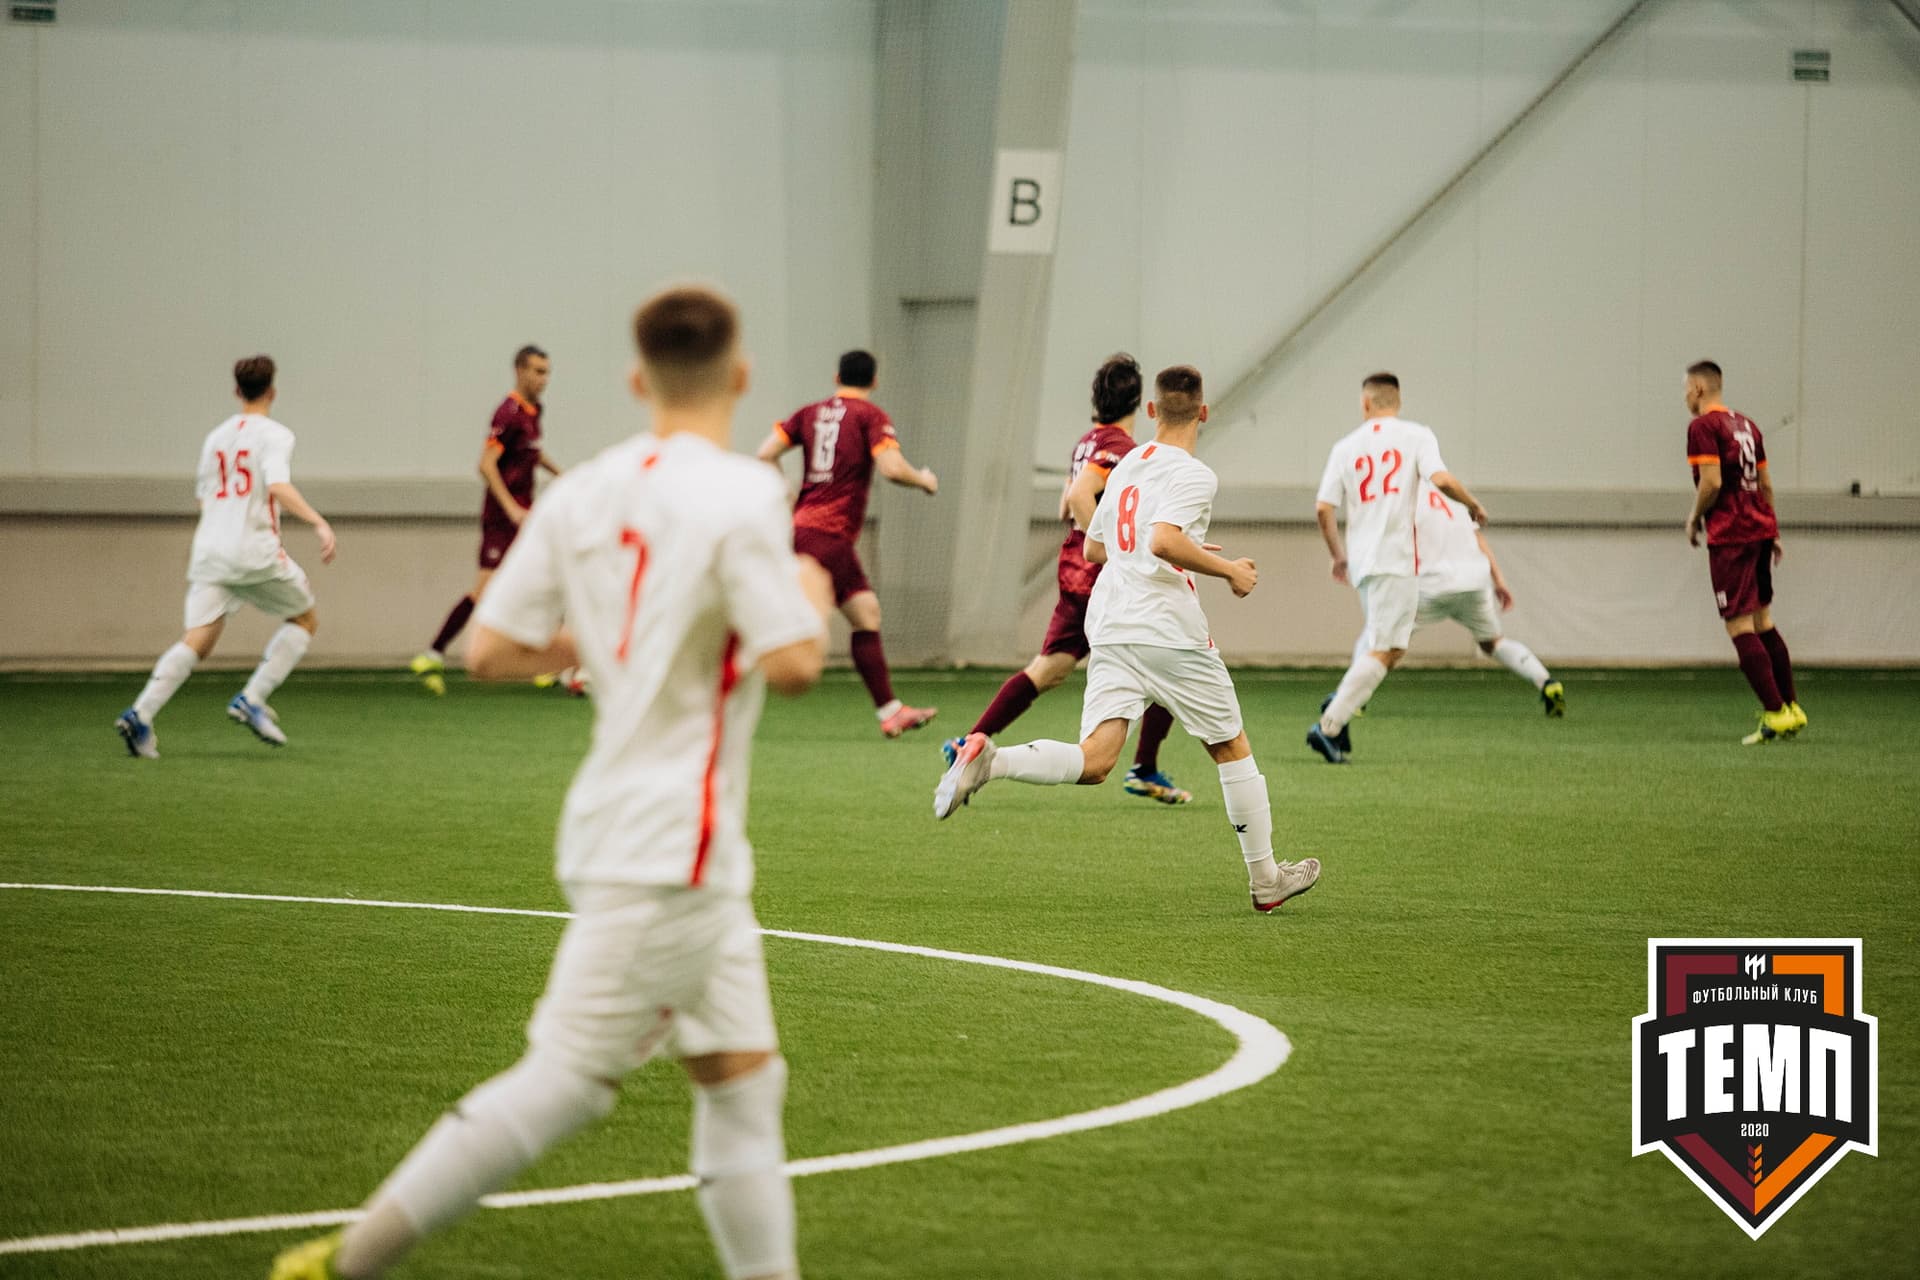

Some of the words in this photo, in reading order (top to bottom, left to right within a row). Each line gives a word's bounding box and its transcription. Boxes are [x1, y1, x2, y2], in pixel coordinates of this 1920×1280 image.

[1009, 178, 1042, 225] B
[215, 449, 253, 499] 15
[1354, 448, 1403, 503] 22
[1117, 485, 1139, 553] 8
[618, 528, 650, 663] 7
